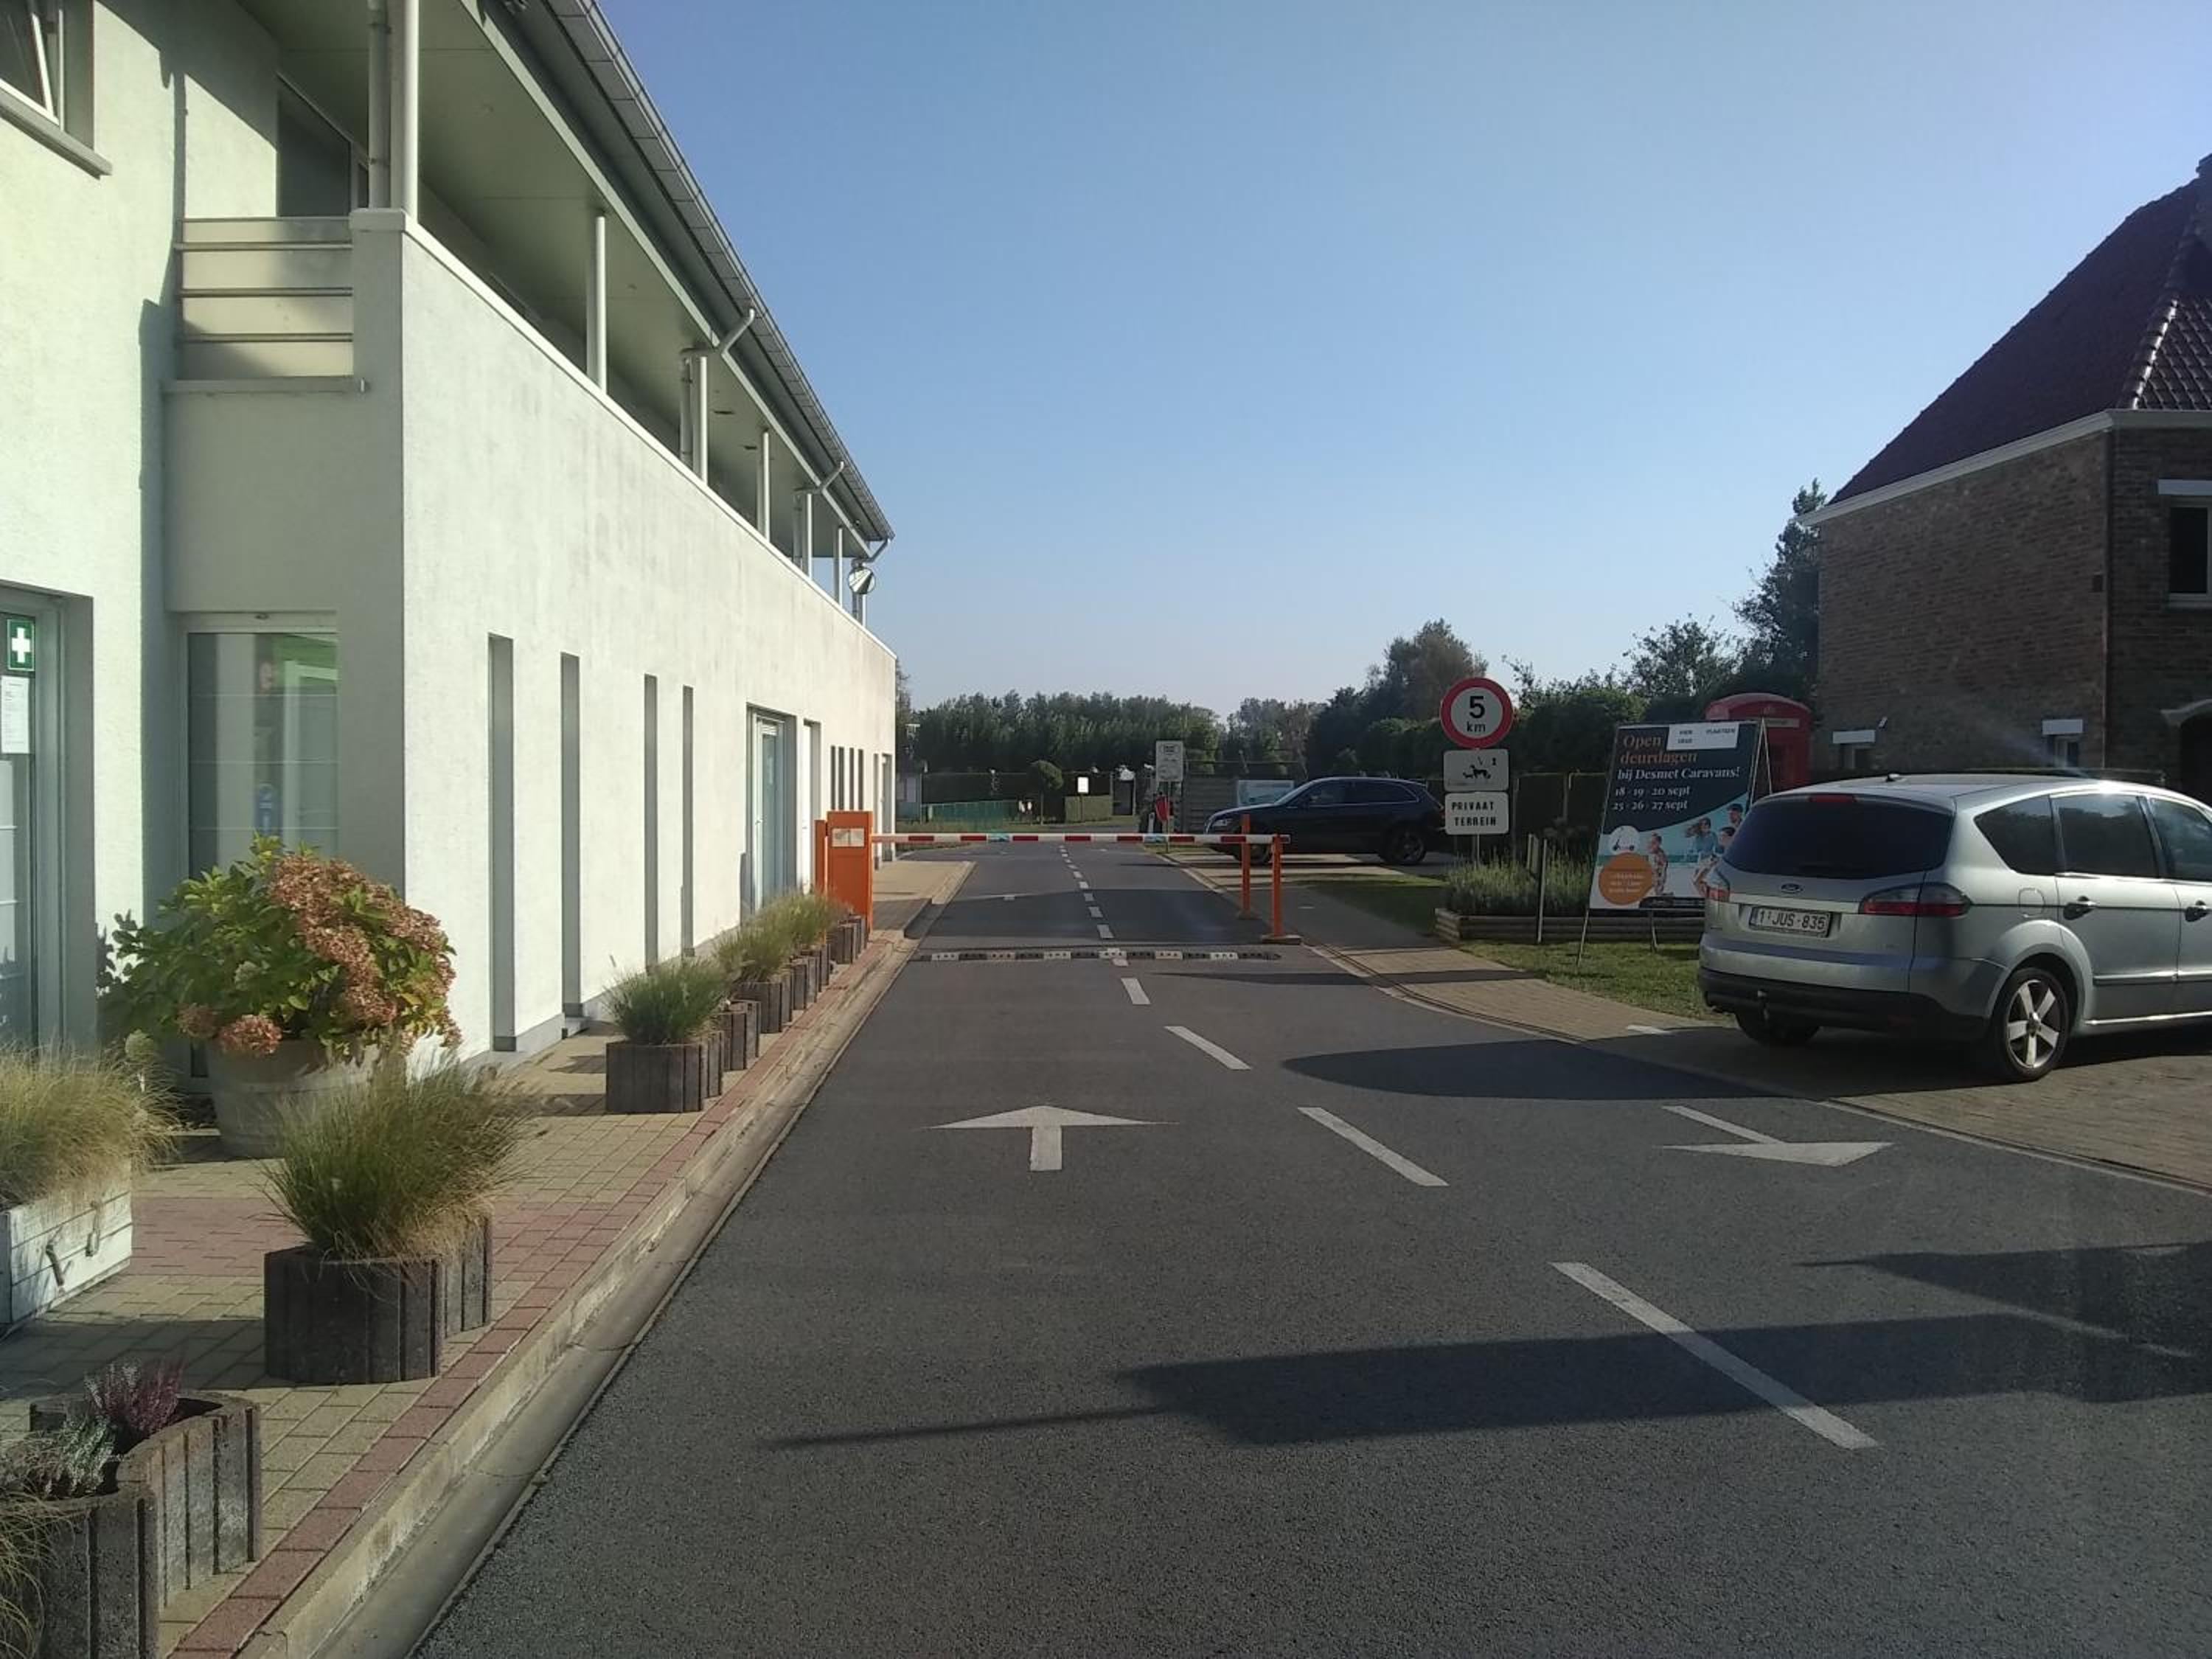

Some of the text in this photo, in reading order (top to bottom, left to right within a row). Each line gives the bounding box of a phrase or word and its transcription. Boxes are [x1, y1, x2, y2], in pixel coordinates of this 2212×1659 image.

[1470, 696, 1485, 718] 5
[1467, 722, 1485, 732] km
[1623, 735, 1661, 749] Open
[1620, 751, 1697, 765] deurdagen
[1617, 766, 1741, 782] bij Desmet Caravans!
[1615, 786, 1690, 797] 18 19 20 sept
[1452, 802, 1494, 810] PRIVAAT
[1632, 801, 1645, 810] 26
[1652, 801, 1664, 810] 27
[1666, 801, 1687, 811] sept
[1454, 816, 1497, 827] TERREIN
